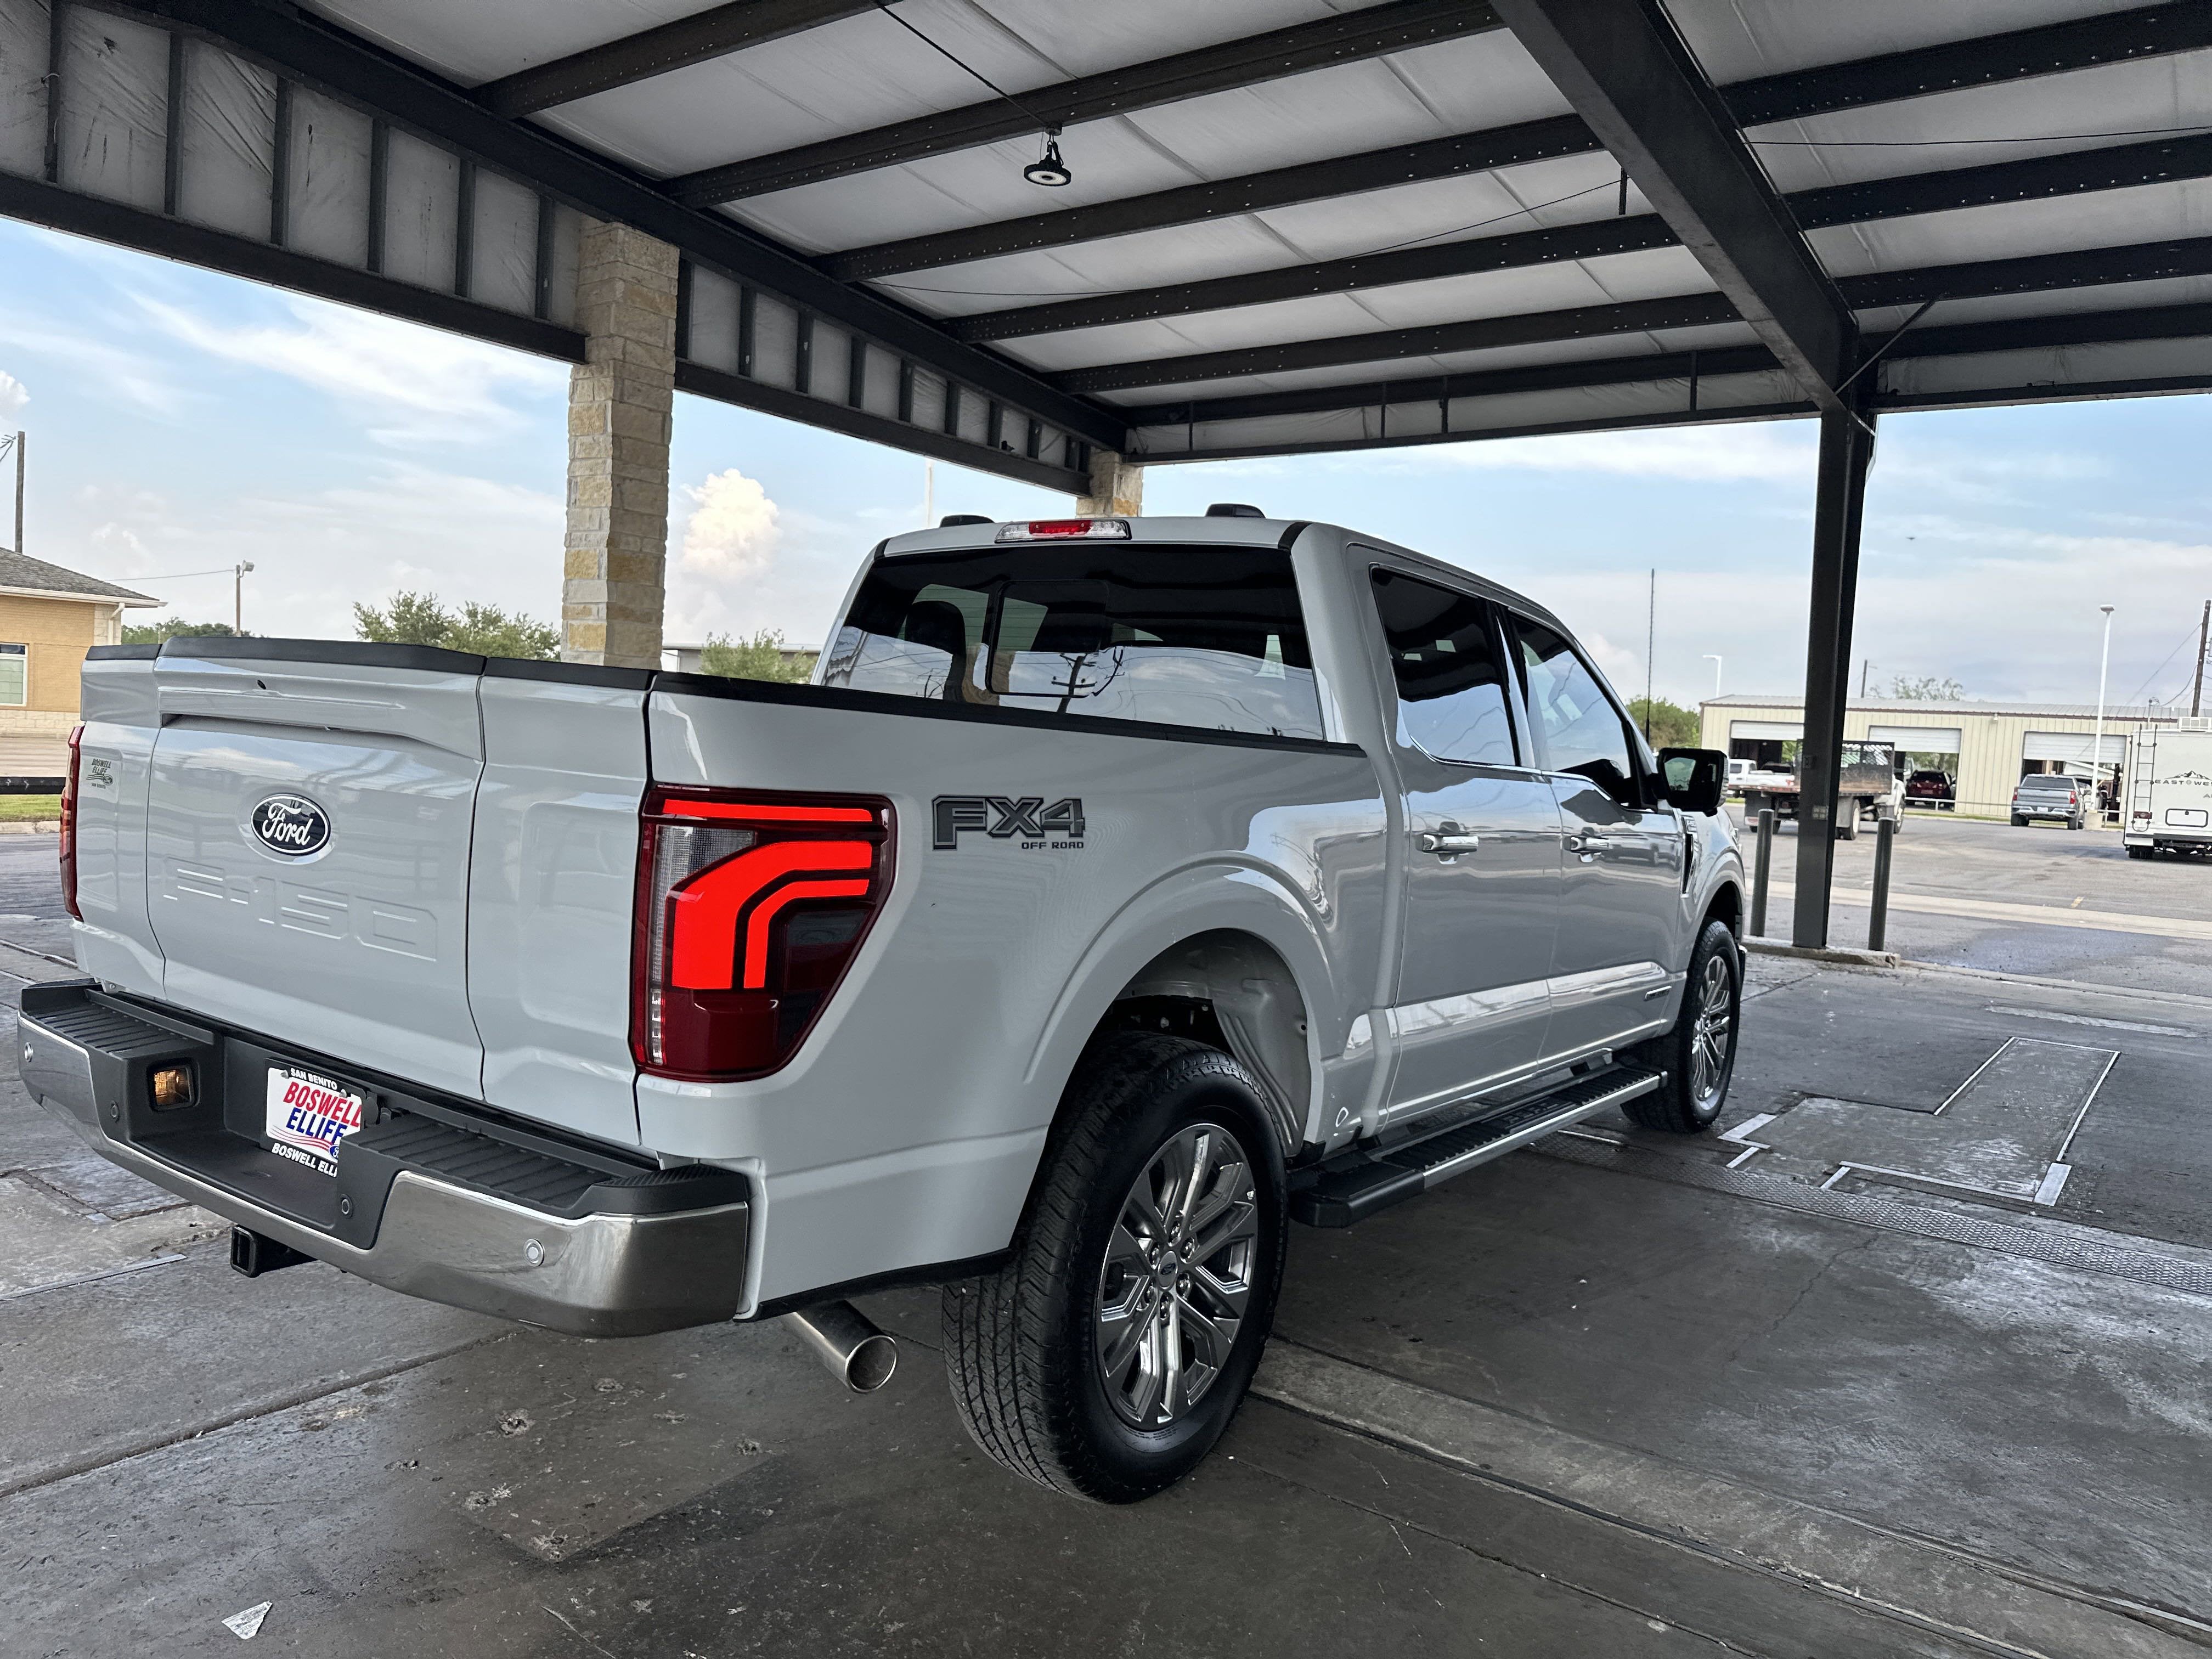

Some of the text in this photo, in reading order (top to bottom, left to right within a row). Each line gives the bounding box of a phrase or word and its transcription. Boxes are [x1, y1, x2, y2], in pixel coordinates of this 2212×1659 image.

[262, 802, 314, 845] Ford
[932, 794, 1085, 851] FX4
[1051, 841, 1084, 849] ROAD
[291, 1068, 337, 1090] SAN BENITO
[283, 1081, 362, 1127] BOSWELL
[286, 1107, 348, 1144] ELLIFF
[272, 1143, 316, 1169] BOSWELL
[318, 1161, 337, 1177] ELLI
